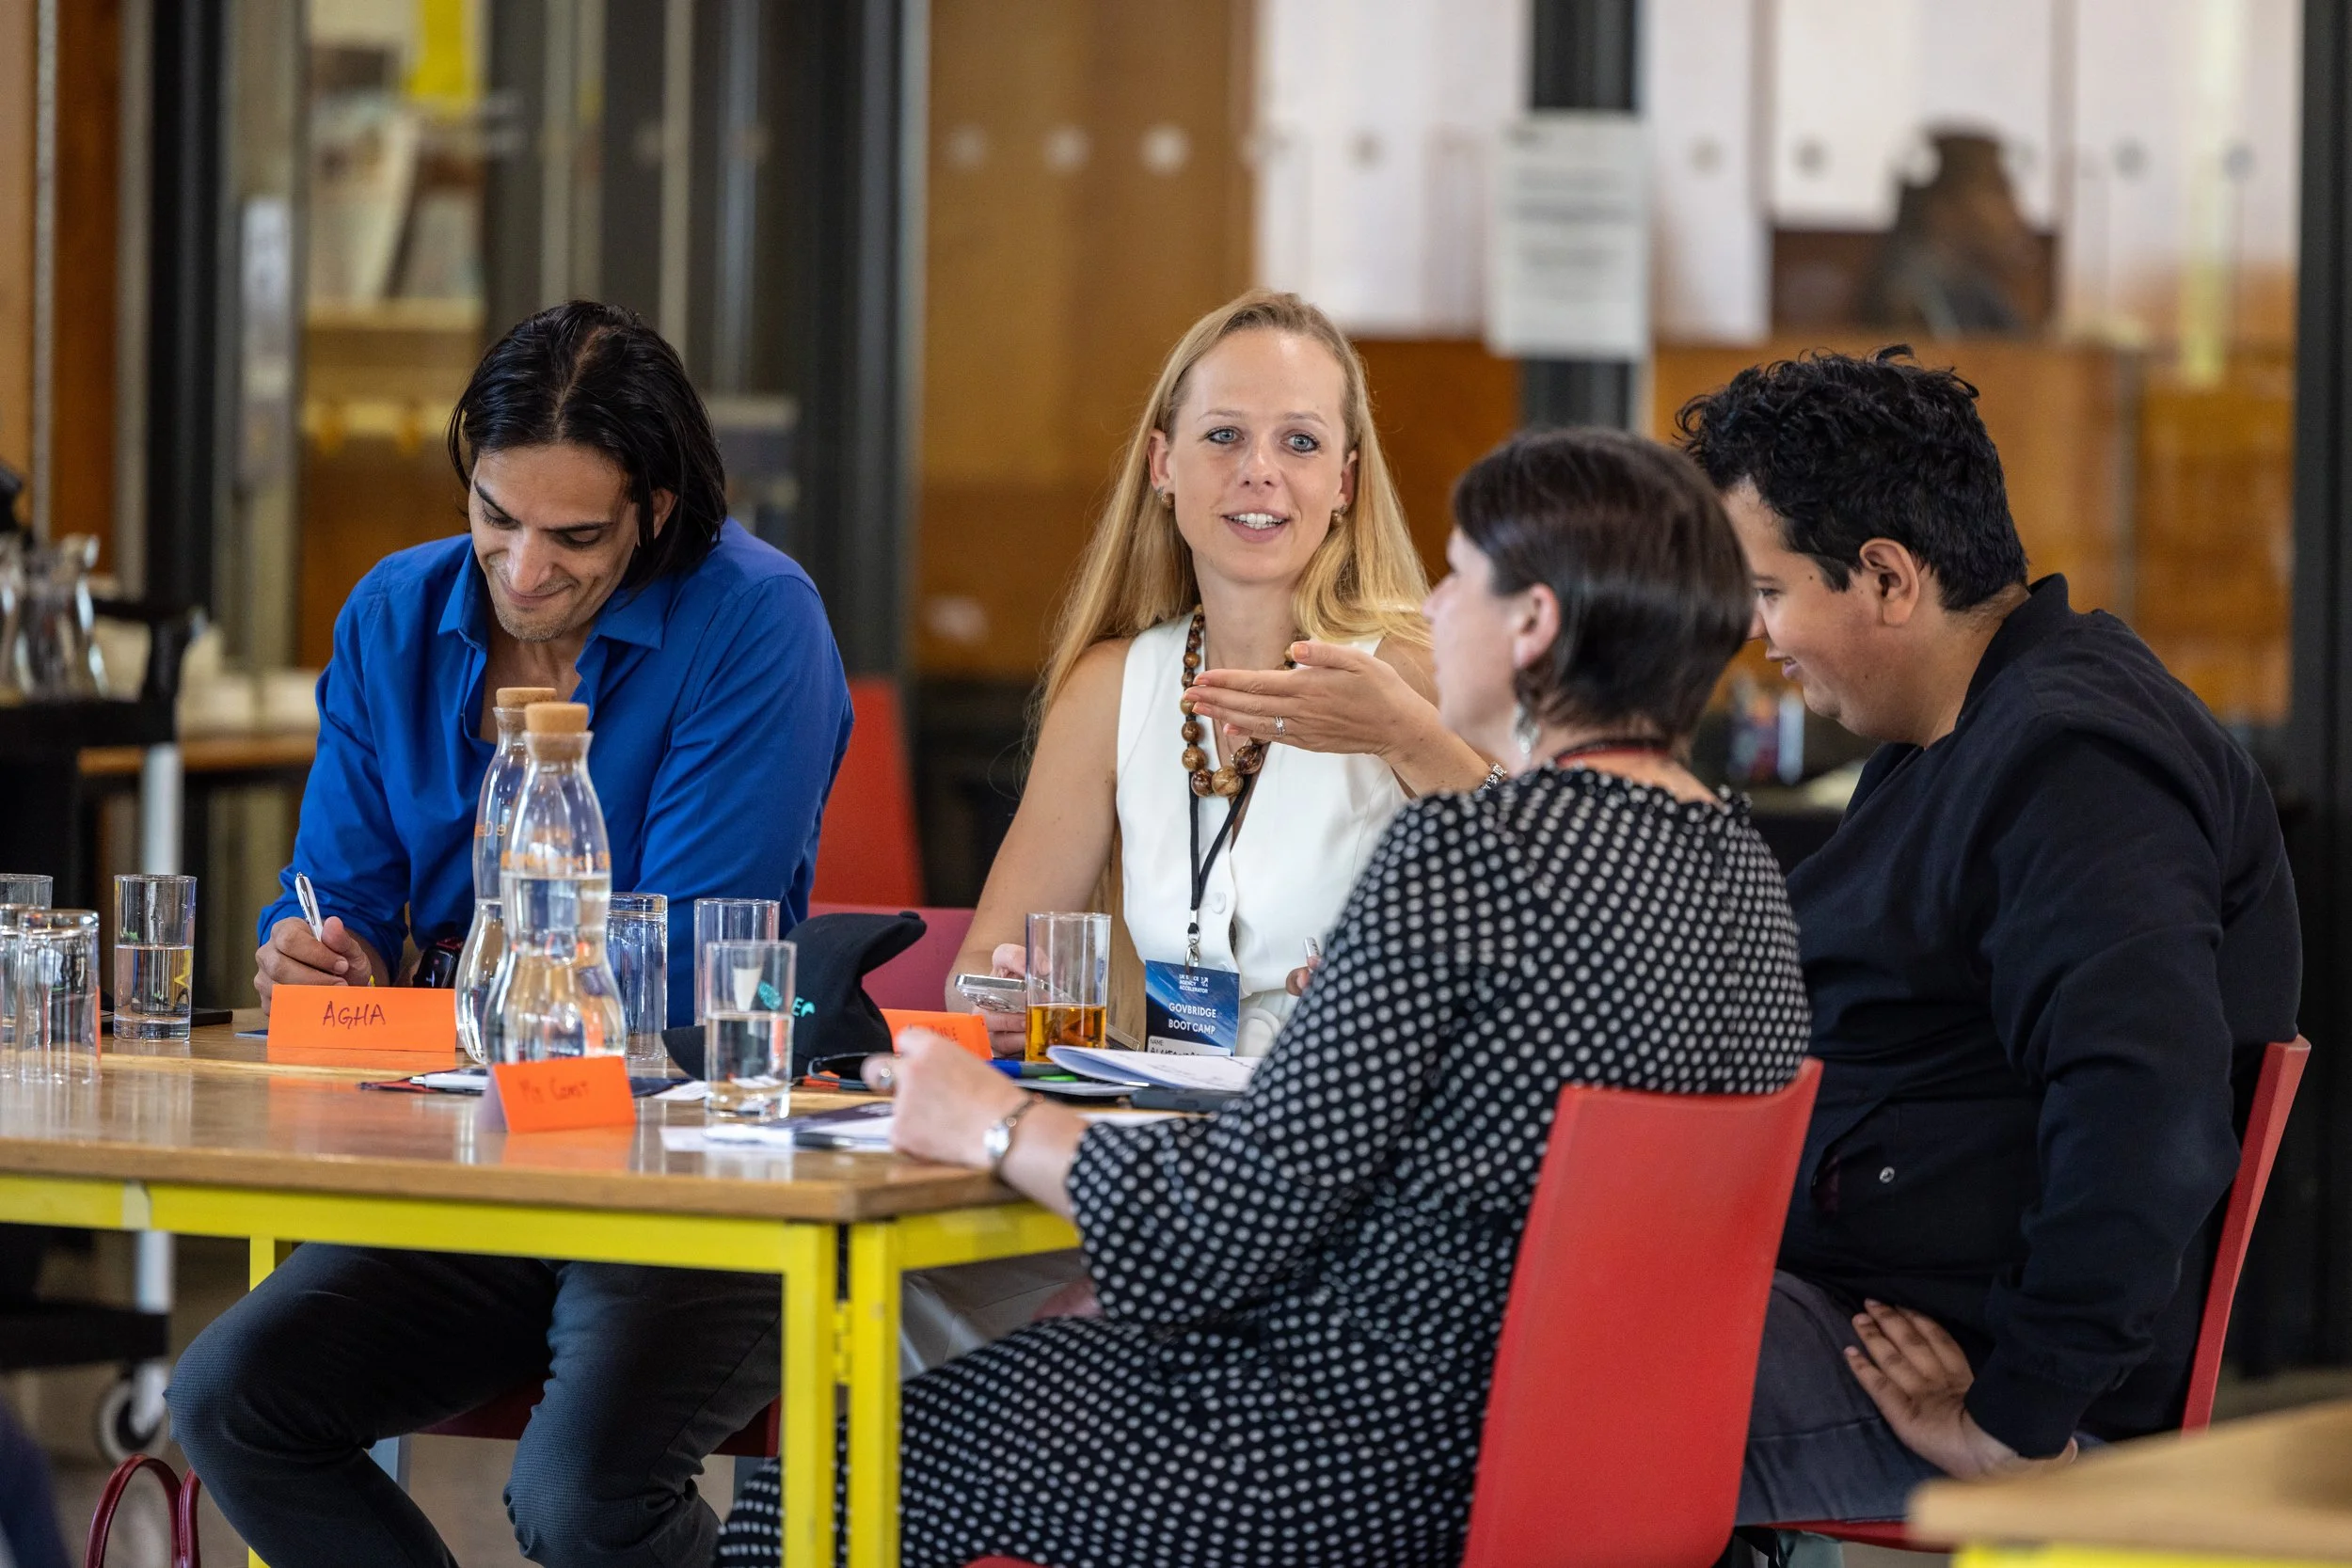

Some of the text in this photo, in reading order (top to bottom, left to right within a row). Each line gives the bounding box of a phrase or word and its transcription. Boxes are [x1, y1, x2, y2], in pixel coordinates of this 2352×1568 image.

[1179, 985, 1209, 994] ACCELERATOR
[323, 1000, 387, 1030] AGHA
[1168, 1002, 1216, 1019] GOVBRIDGE
[1168, 1019, 1216, 1036] BOOT CAMP
